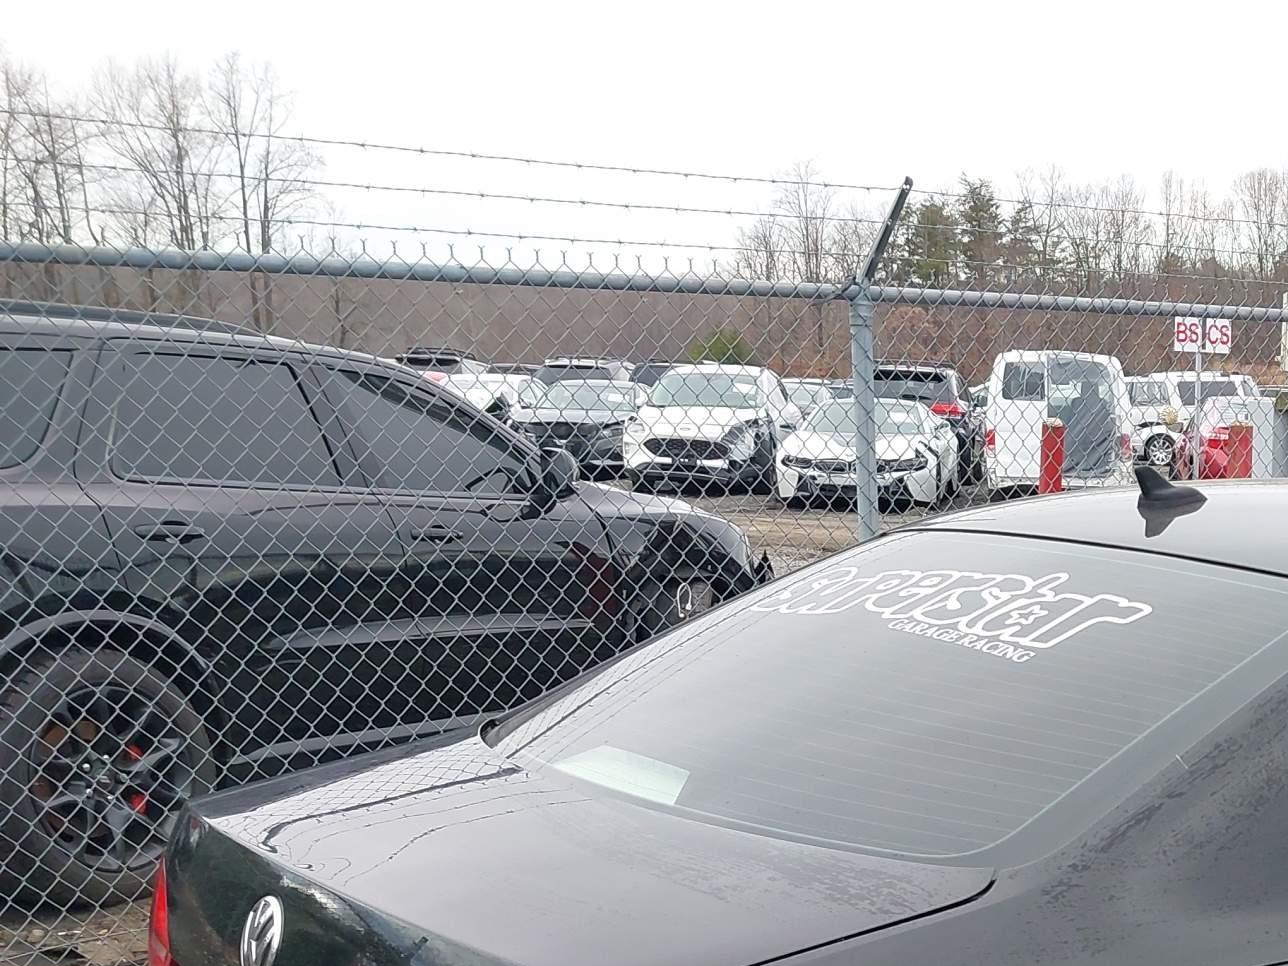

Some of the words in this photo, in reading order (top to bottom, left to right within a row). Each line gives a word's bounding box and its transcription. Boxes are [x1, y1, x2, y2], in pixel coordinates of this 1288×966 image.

[1176, 322, 1199, 343] BS
[1207, 324, 1230, 345] CS
[887, 619, 962, 642] GARAGE
[957, 632, 1036, 663] RACING
